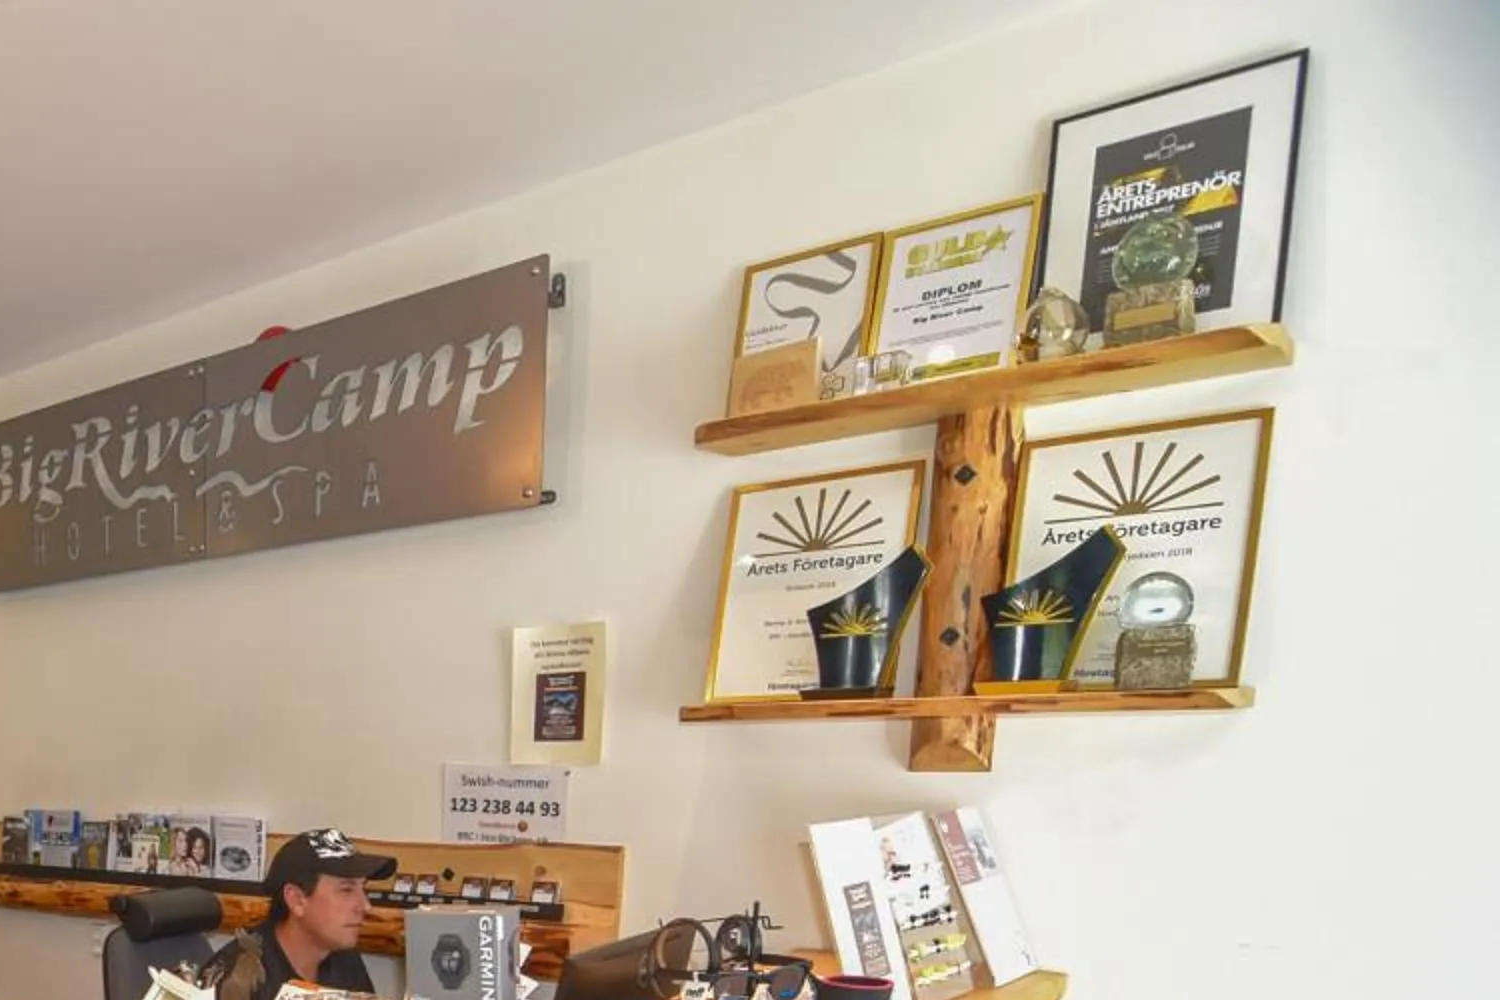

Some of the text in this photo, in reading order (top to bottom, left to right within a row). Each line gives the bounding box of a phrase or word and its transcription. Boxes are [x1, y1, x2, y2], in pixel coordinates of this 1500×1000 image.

[1095, 169, 1242, 219] ENTREPRENÖR
[921, 279, 983, 301] DIPLOM
[33, 501, 186, 568] HOTEL
[272, 461, 381, 525] SPA
[1112, 515, 1223, 539] öretagare
[792, 552, 883, 571] Företagare
[461, 774, 549, 789] Swish-nummer
[451, 797, 561, 817] 123 238 44 93
